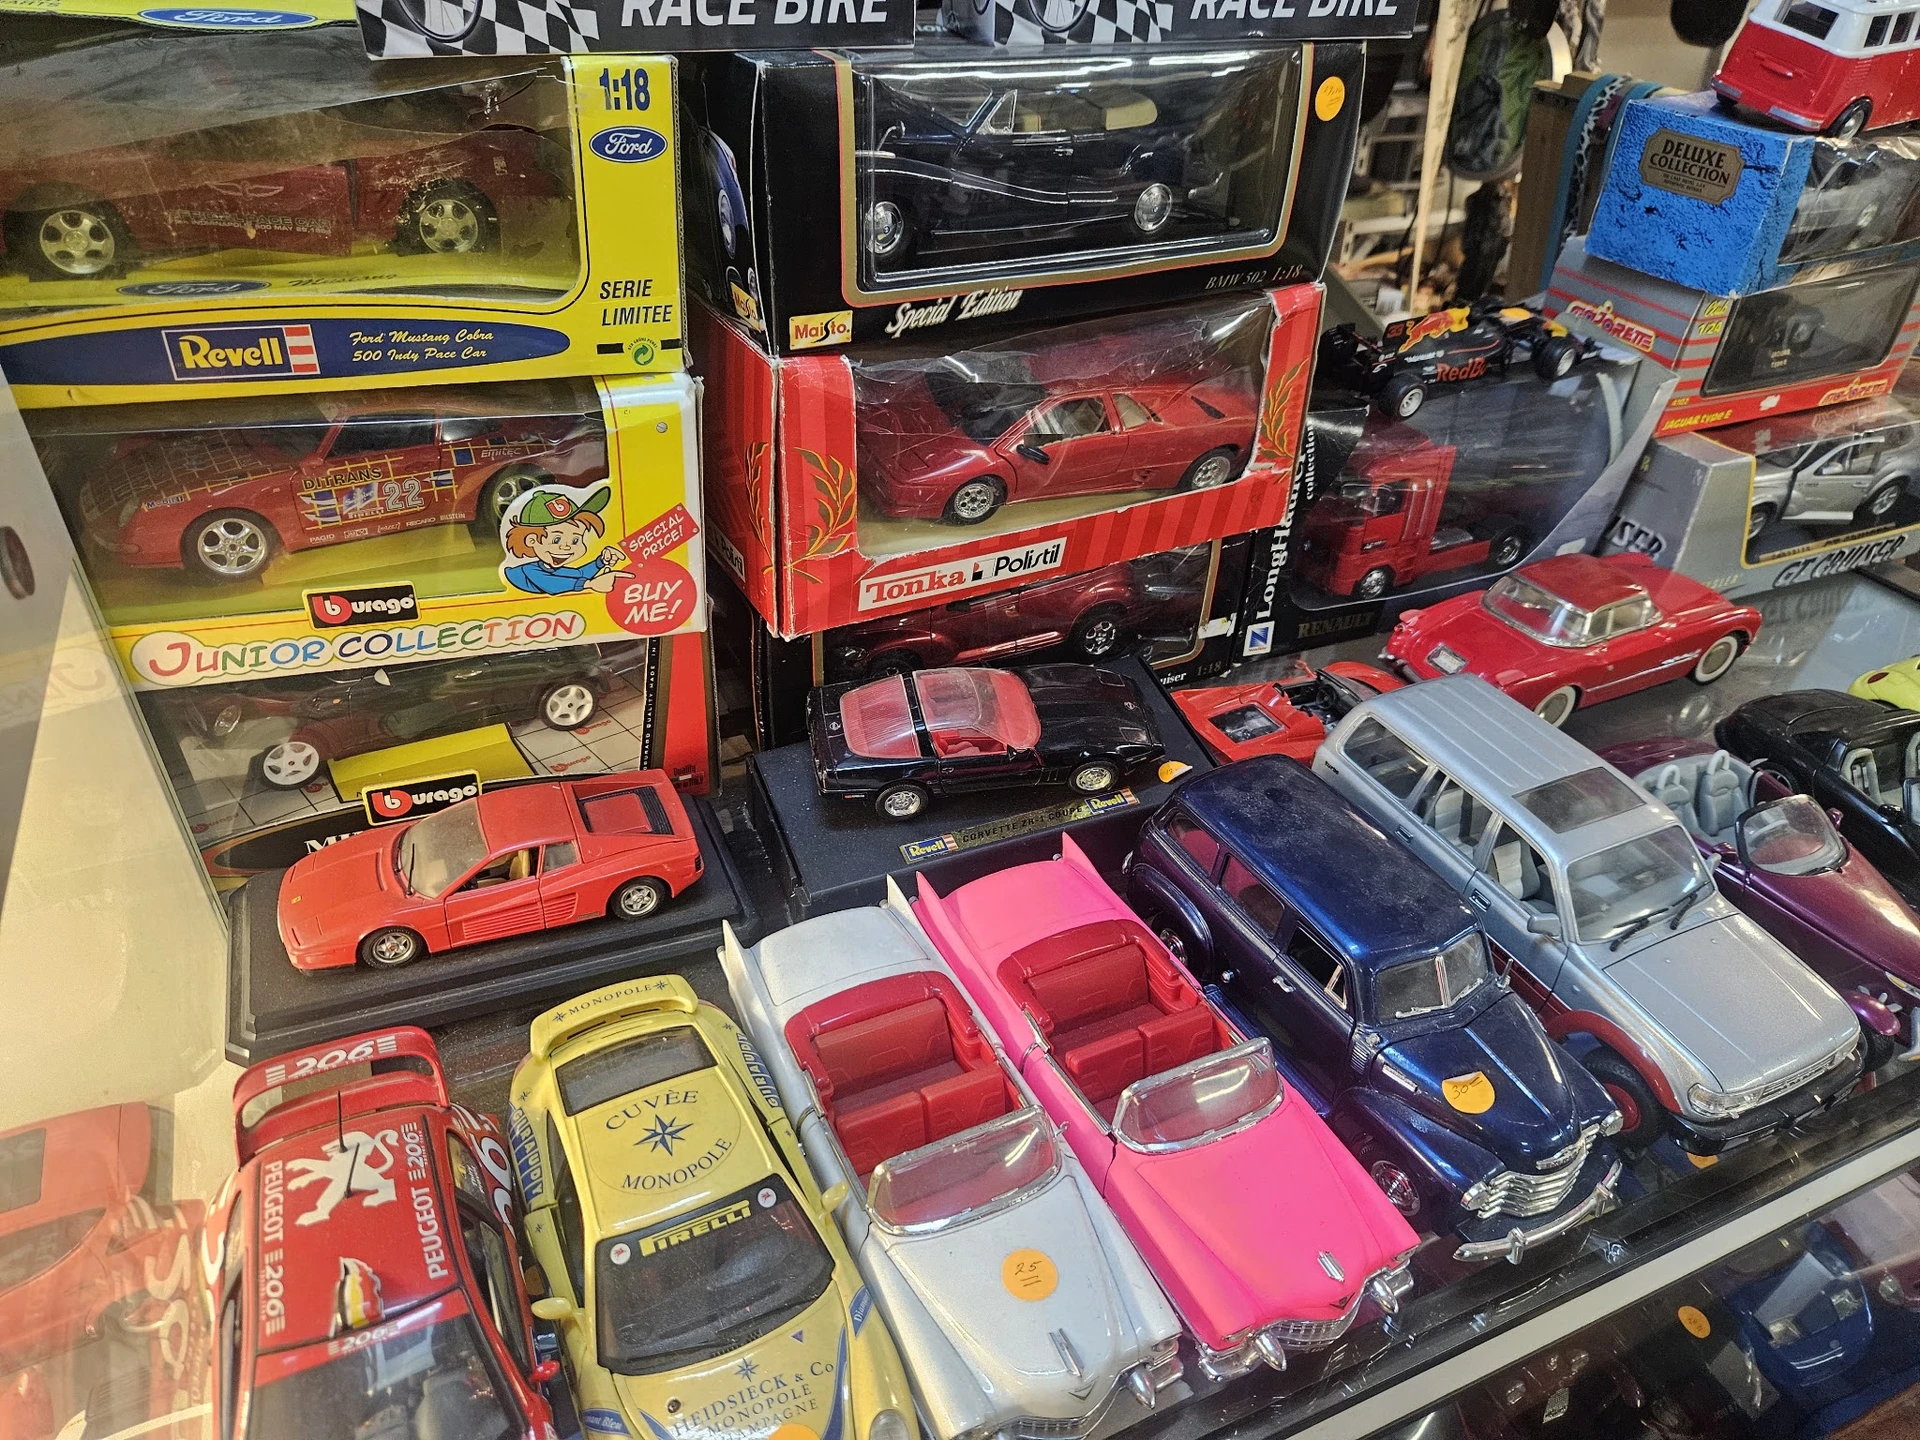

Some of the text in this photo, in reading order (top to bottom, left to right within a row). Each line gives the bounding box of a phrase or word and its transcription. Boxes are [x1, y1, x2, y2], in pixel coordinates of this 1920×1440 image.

[173, 10, 283, 24] Ford
[599, 67, 650, 112] 1:18
[604, 133, 654, 156] Ford
[1662, 139, 1727, 169] DELUXE
[1650, 153, 1730, 185] COLLECTION
[295, 217, 332, 229] CAR
[147, 283, 245, 295] Ford
[600, 279, 653, 300] SERIE
[1205, 264, 1304, 290] BMW 502 1:18
[601, 304, 673, 326] LIMITEE
[885, 287, 1024, 339] Special Edition
[1704, 300, 1728, 318] Club
[349, 329, 494, 346] Ford Mustang Cobra
[794, 312, 850, 344] Maisto
[179, 334, 284, 369] Revell
[352, 345, 488, 362] 500 Indy Pace Car
[1661, 413, 1702, 431] JAGUAR
[1723, 408, 1733, 420] E
[1305, 424, 1316, 500] collection
[303, 467, 383, 491] DITRANS
[382, 477, 425, 512] 22
[406, 516, 436, 528] RECARO
[628, 513, 685, 552] SPECIAL
[642, 525, 684, 560] PRICE!
[865, 543, 1061, 603] Tonka Polistil
[624, 579, 683, 605] BUY
[624, 599, 683, 625] ME!
[1298, 611, 1374, 638] RENAULT
[149, 614, 577, 678] JUNIOR COLLECTION
[651, 647, 657, 656] IN
[1159, 671, 1187, 685] uiser
[909, 795, 1126, 858] Revell CORVETTE ZR-1 COUPE Revell
[568, 983, 653, 1016] MONOPOLE
[287, 1040, 376, 1078] 206
[511, 1107, 545, 1197] GIRAUDY
[620, 1138, 733, 1191] MONOPOLE
[405, 1131, 449, 1280] PEUGEOT 206
[264, 1159, 284, 1317] PEUGEOT 206
[638, 1199, 752, 1258] PIRELLI
[1014, 1260, 1043, 1276] 25
[341, 1325, 388, 1351] 206
[672, 1361, 834, 1438] HEIDSIECK & Co
[705, 1383, 812, 1438] MONOPOLE
